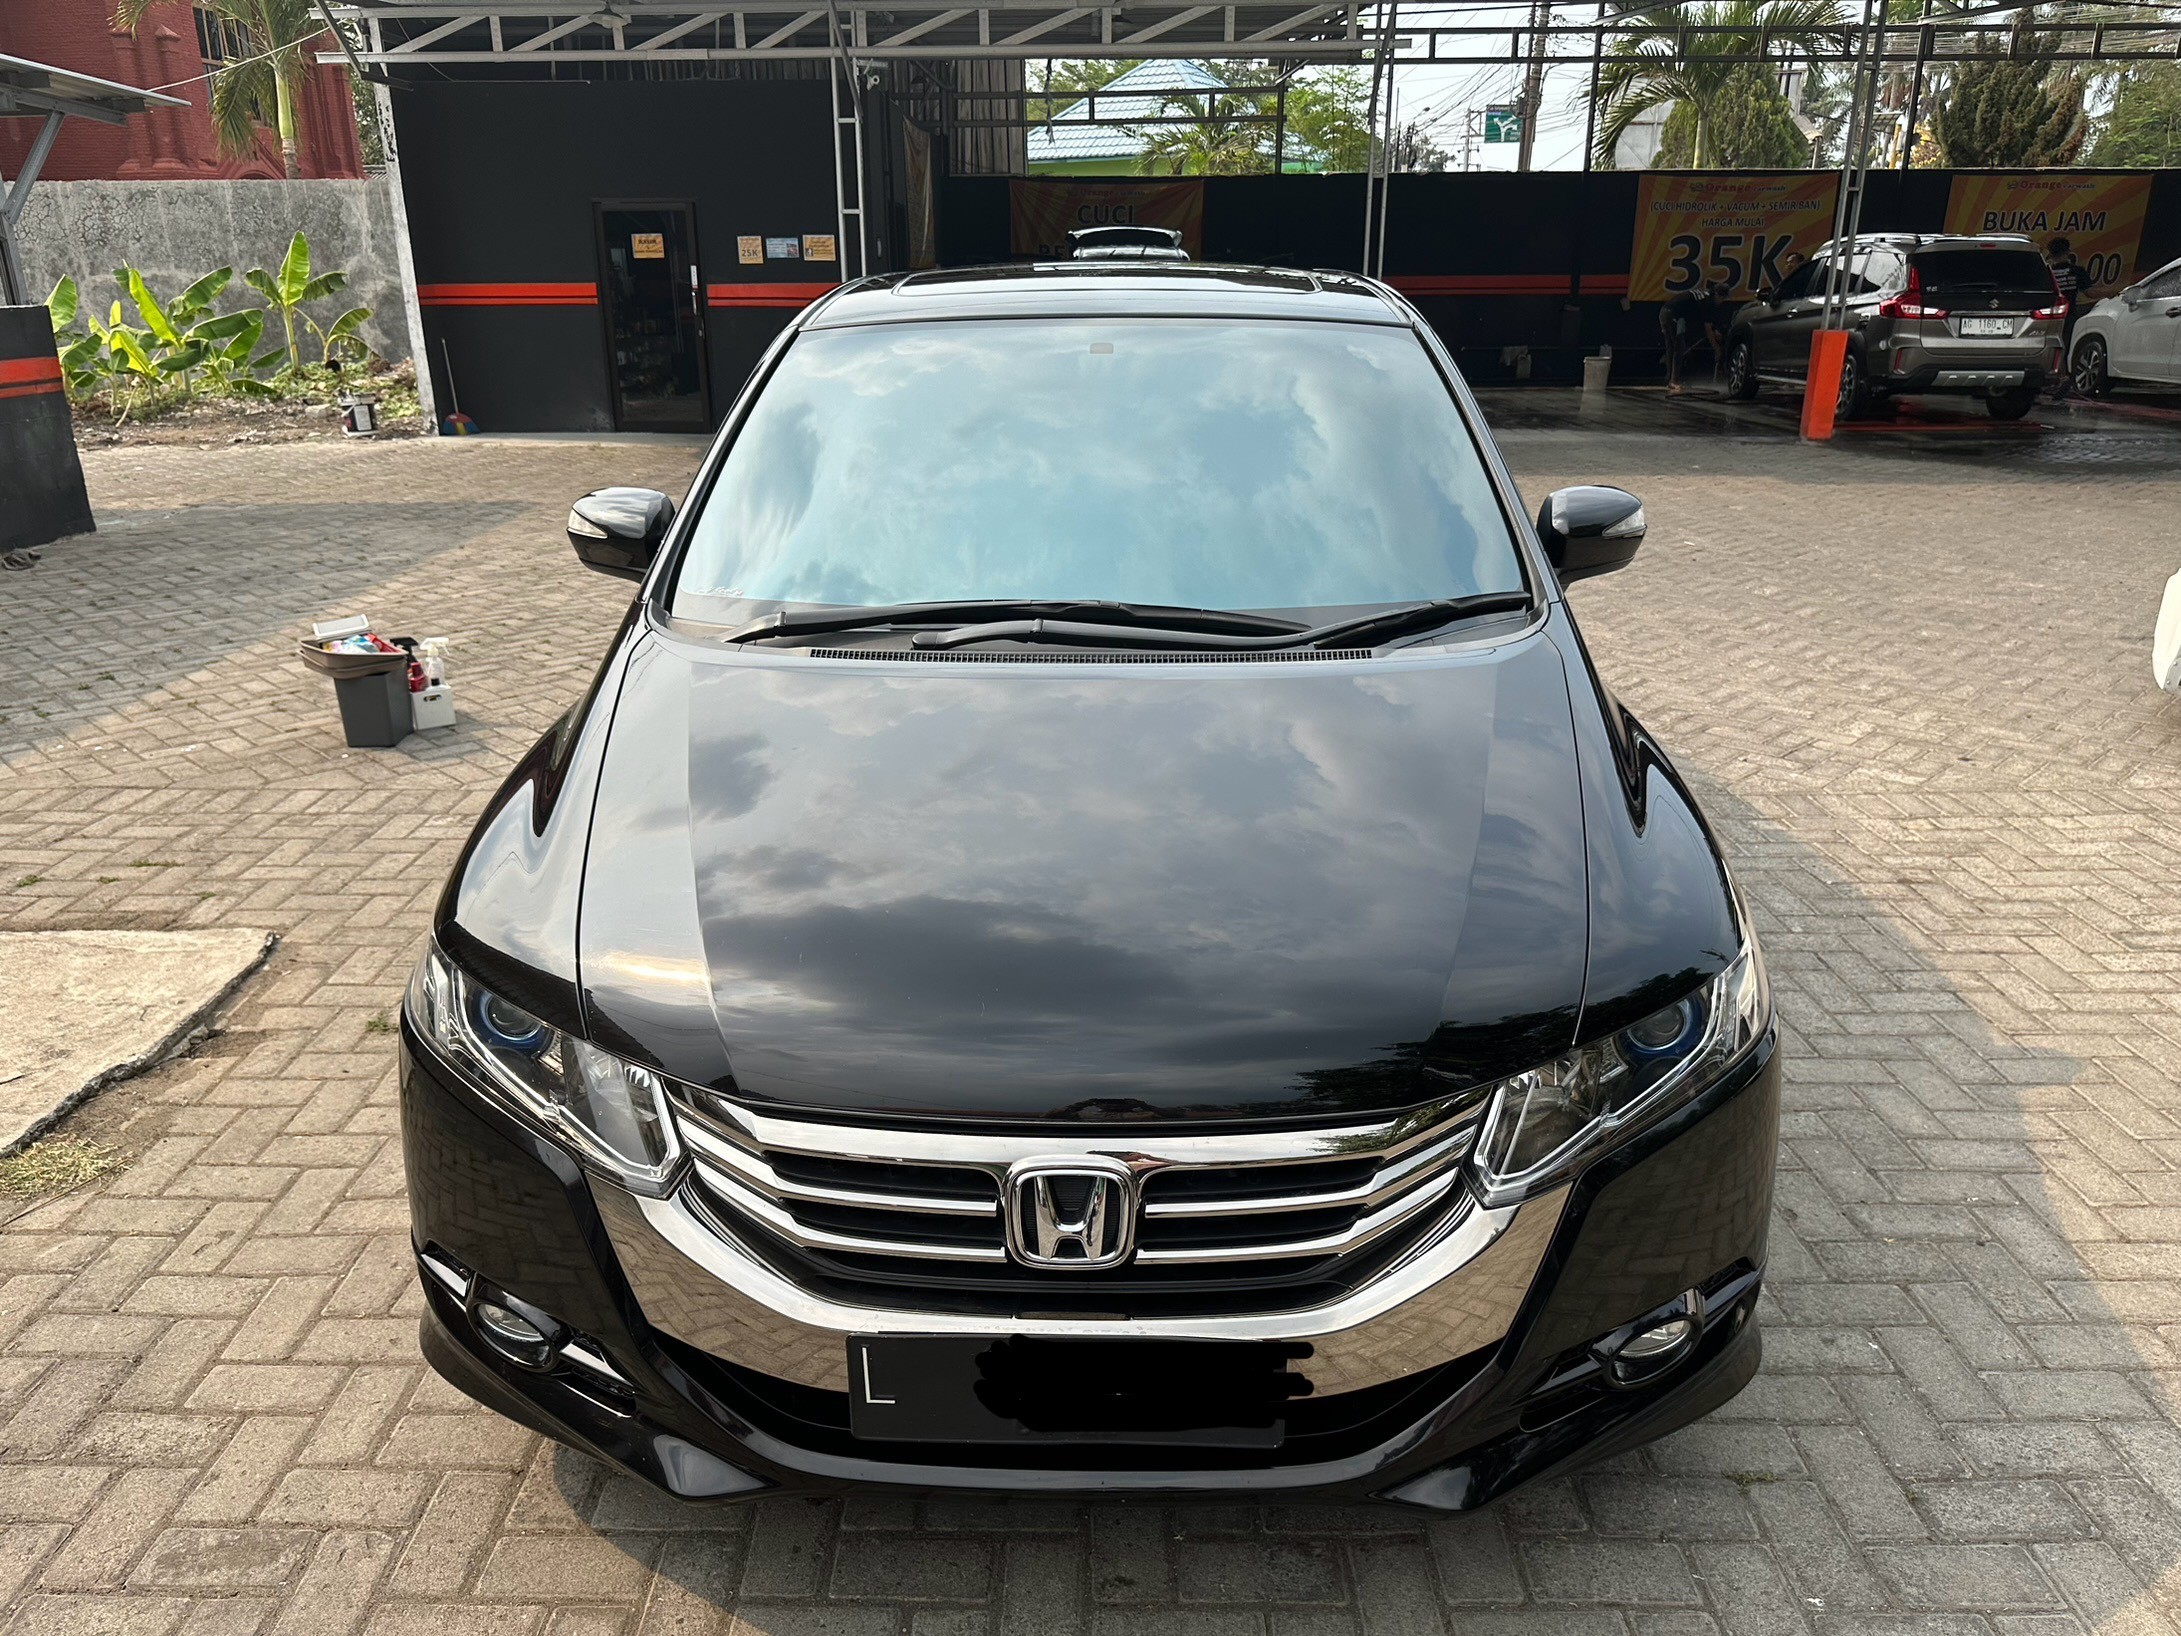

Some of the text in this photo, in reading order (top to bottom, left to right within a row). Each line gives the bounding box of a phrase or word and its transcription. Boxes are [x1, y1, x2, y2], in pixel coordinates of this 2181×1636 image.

[1077, 204, 1134, 225] CUCI
[1701, 217, 1764, 227] HARGA MULAI
[1982, 211, 2107, 232] BUKA JAM
[741, 249, 758, 257] 25K
[1664, 234, 1792, 292] 35K
[1963, 319, 1973, 329] AG
[1979, 319, 1997, 329] 1160
[862, 1345, 895, 1404] L
